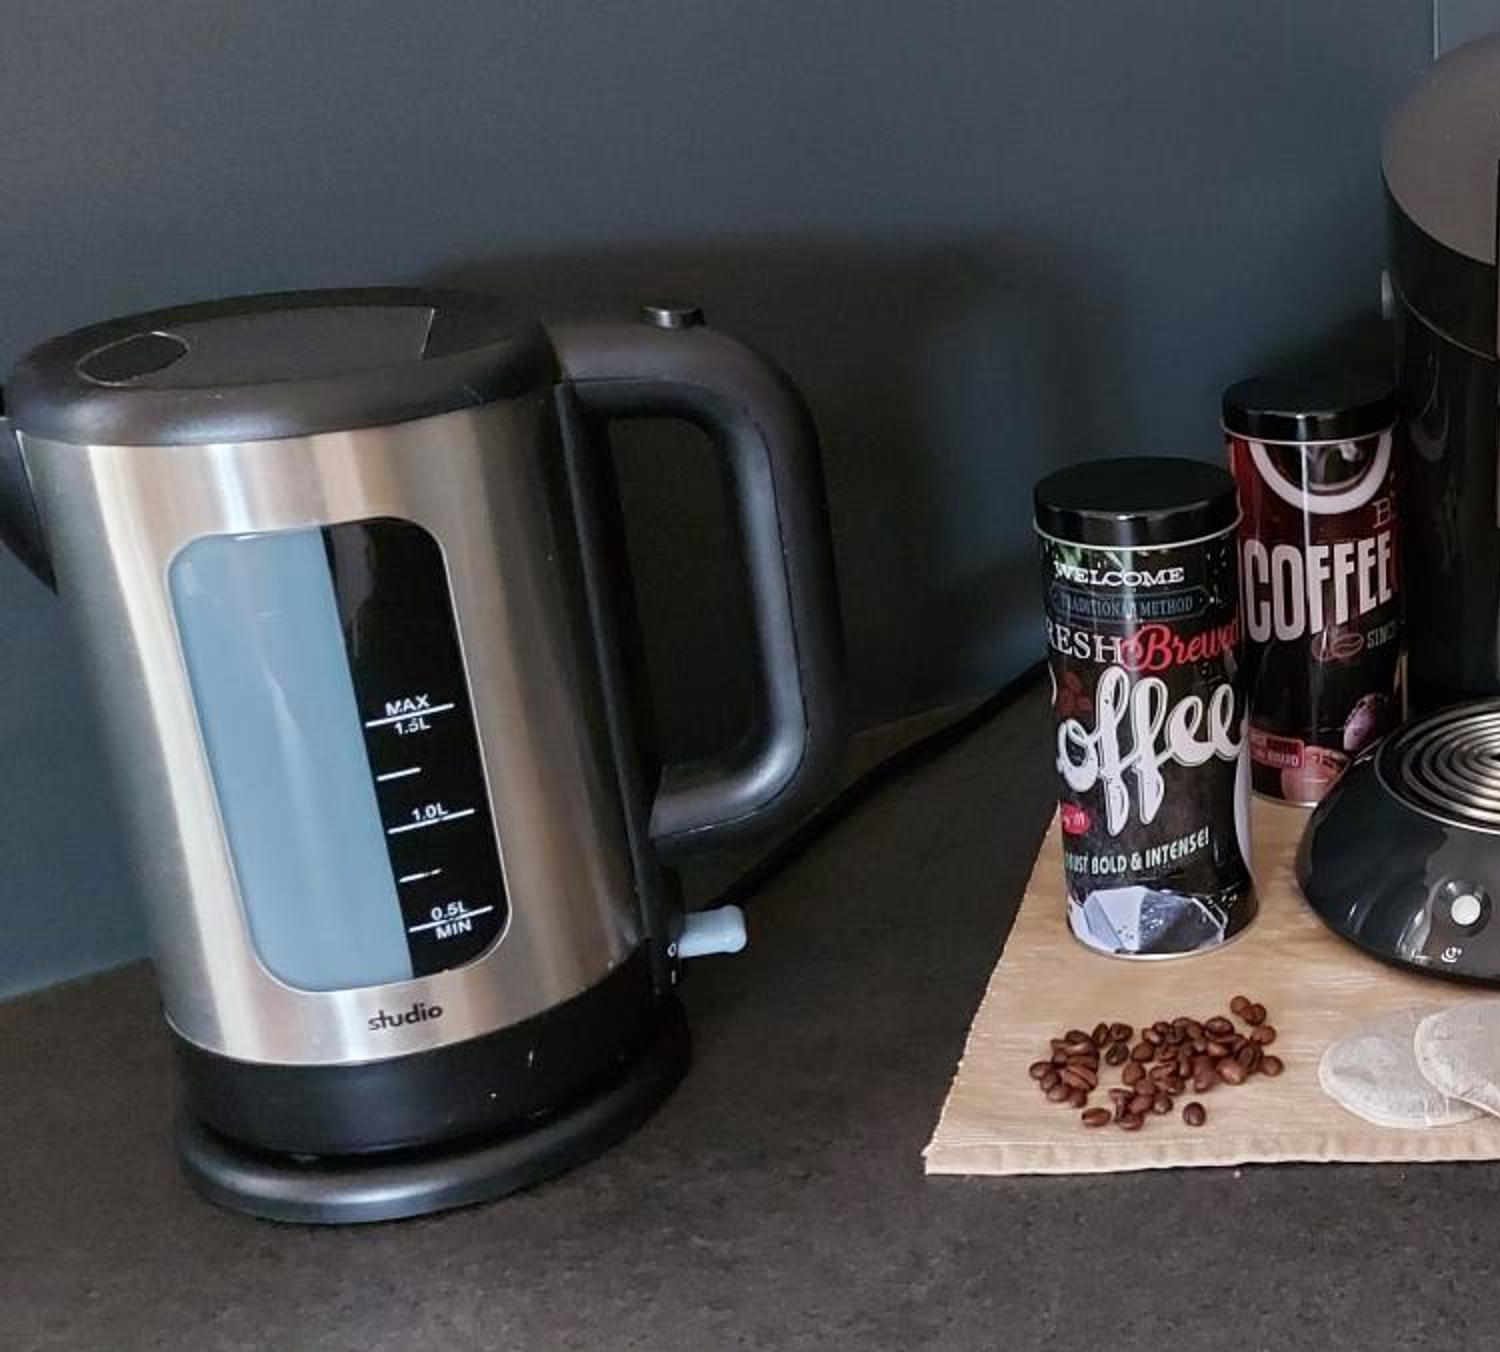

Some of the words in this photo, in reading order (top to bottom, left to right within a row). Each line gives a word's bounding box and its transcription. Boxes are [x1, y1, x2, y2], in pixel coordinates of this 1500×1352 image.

[1053, 560, 1185, 587] WELCOME
[1243, 531, 1392, 643] COFFEE
[1139, 594, 1194, 617] METHOD
[1045, 615, 1122, 664] RESH
[385, 694, 431, 716] MAX
[393, 717, 431, 736] 1.5L
[1048, 661, 1240, 837] offee
[411, 802, 449, 822] 1.0L
[1091, 854, 1127, 875] BOLD
[1130, 852, 1143, 871] &
[1145, 827, 1210, 869] INTENSE!
[431, 900, 470, 921] 0.5L
[435, 919, 472, 940] MIN
[368, 1002, 443, 1031] studio
